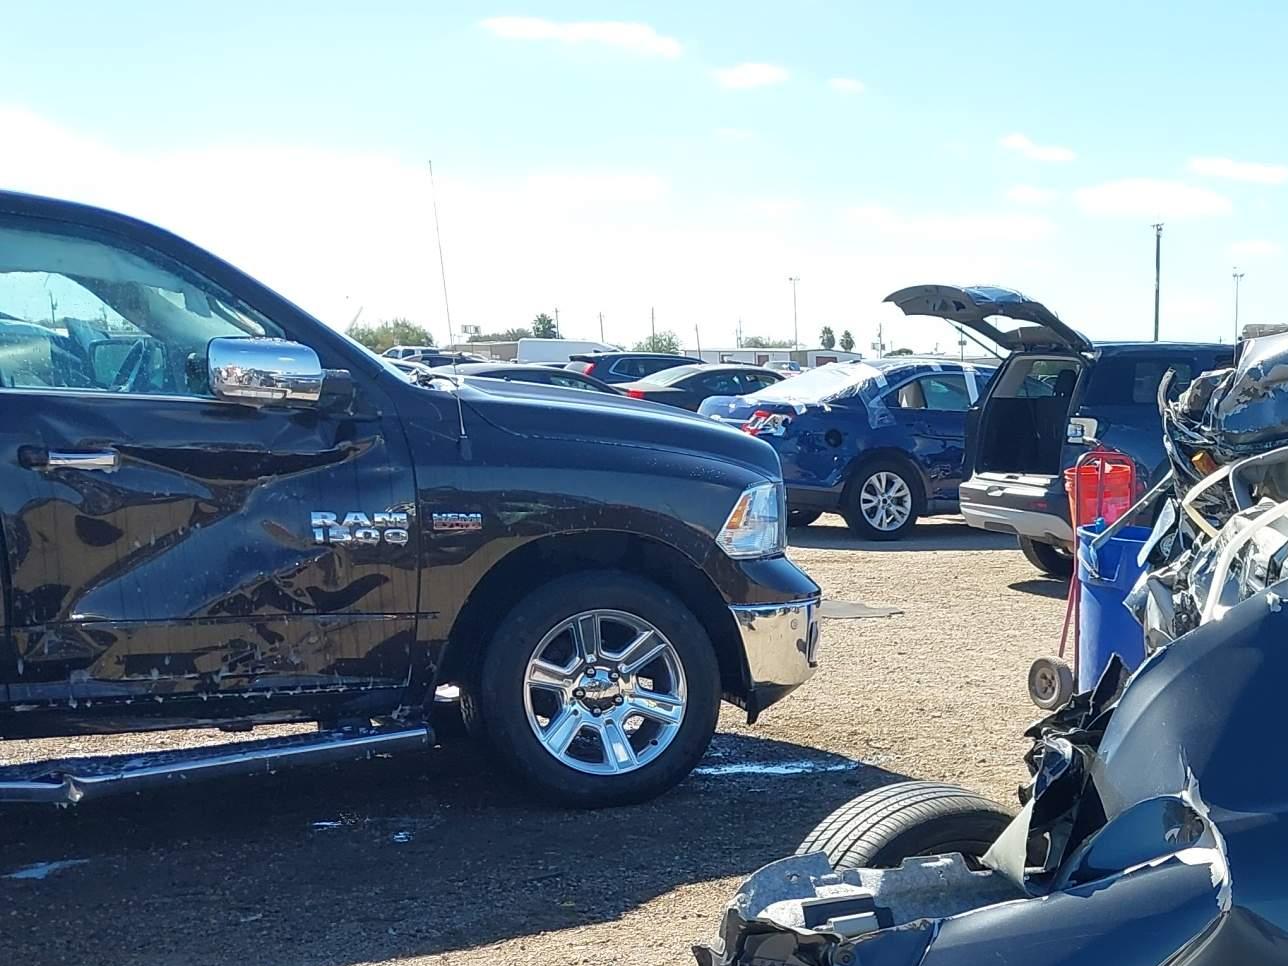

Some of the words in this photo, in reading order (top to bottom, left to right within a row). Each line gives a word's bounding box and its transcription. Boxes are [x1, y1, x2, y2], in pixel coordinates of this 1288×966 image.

[310, 511, 409, 528] RAM
[432, 513, 481, 521] HEMI
[313, 528, 409, 545] 1500
